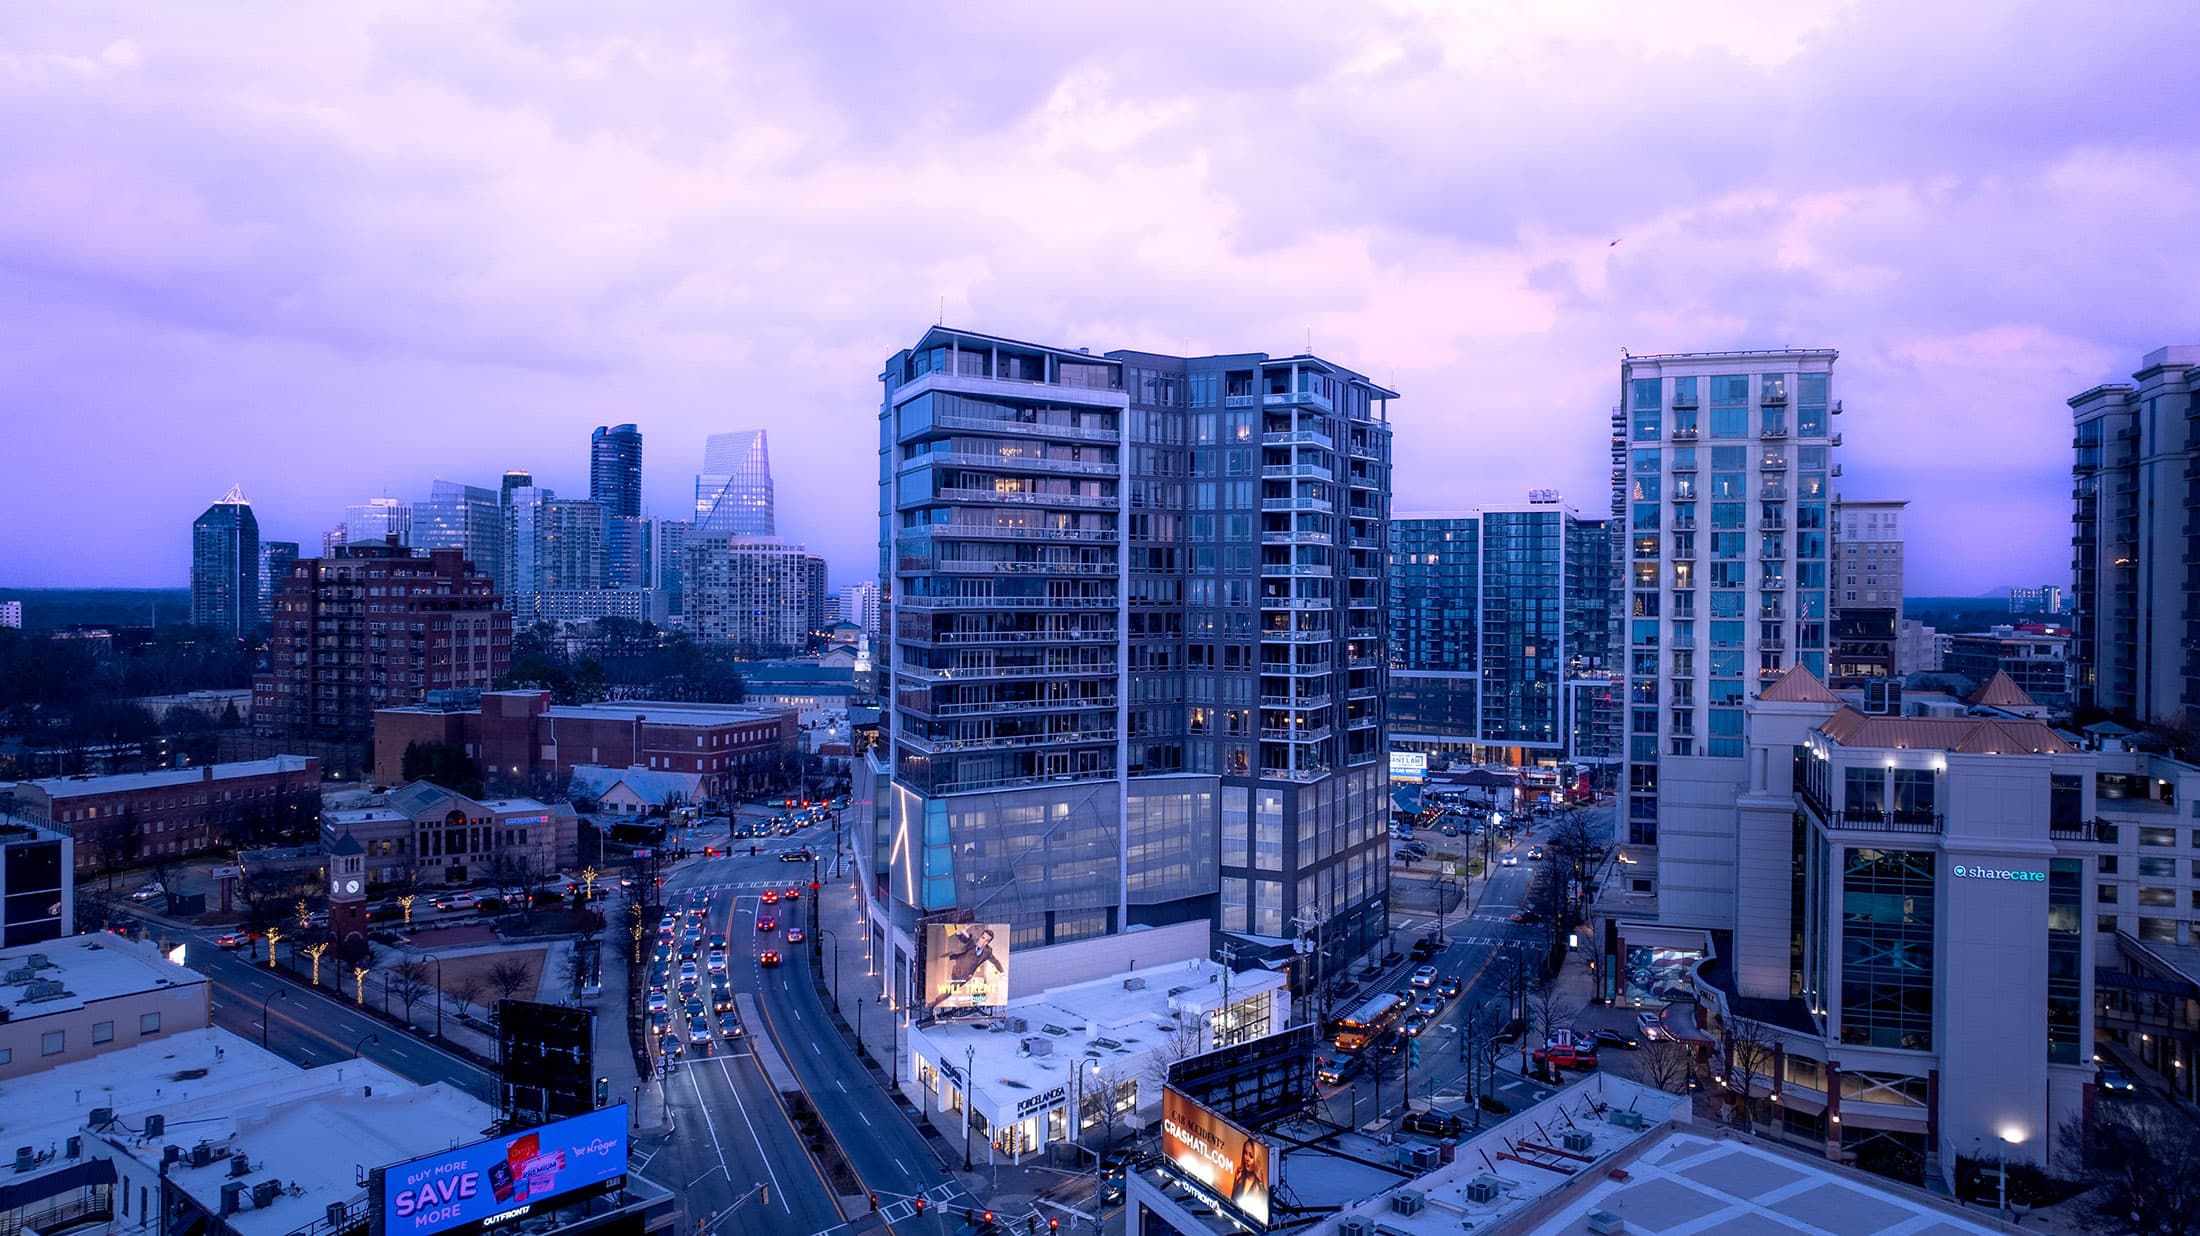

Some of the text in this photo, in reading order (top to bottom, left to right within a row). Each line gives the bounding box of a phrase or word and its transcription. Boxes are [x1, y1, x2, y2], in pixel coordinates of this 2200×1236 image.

[1968, 866, 2045, 881] sharecare
[1017, 1086, 1065, 1112] PORCELANOSA
[1164, 1118, 1234, 1175] CRASHATL.COM
[407, 1160, 468, 1185] BUY MORE
[395, 1172, 479, 1216] SAVE
[415, 1203, 462, 1229] MORE
